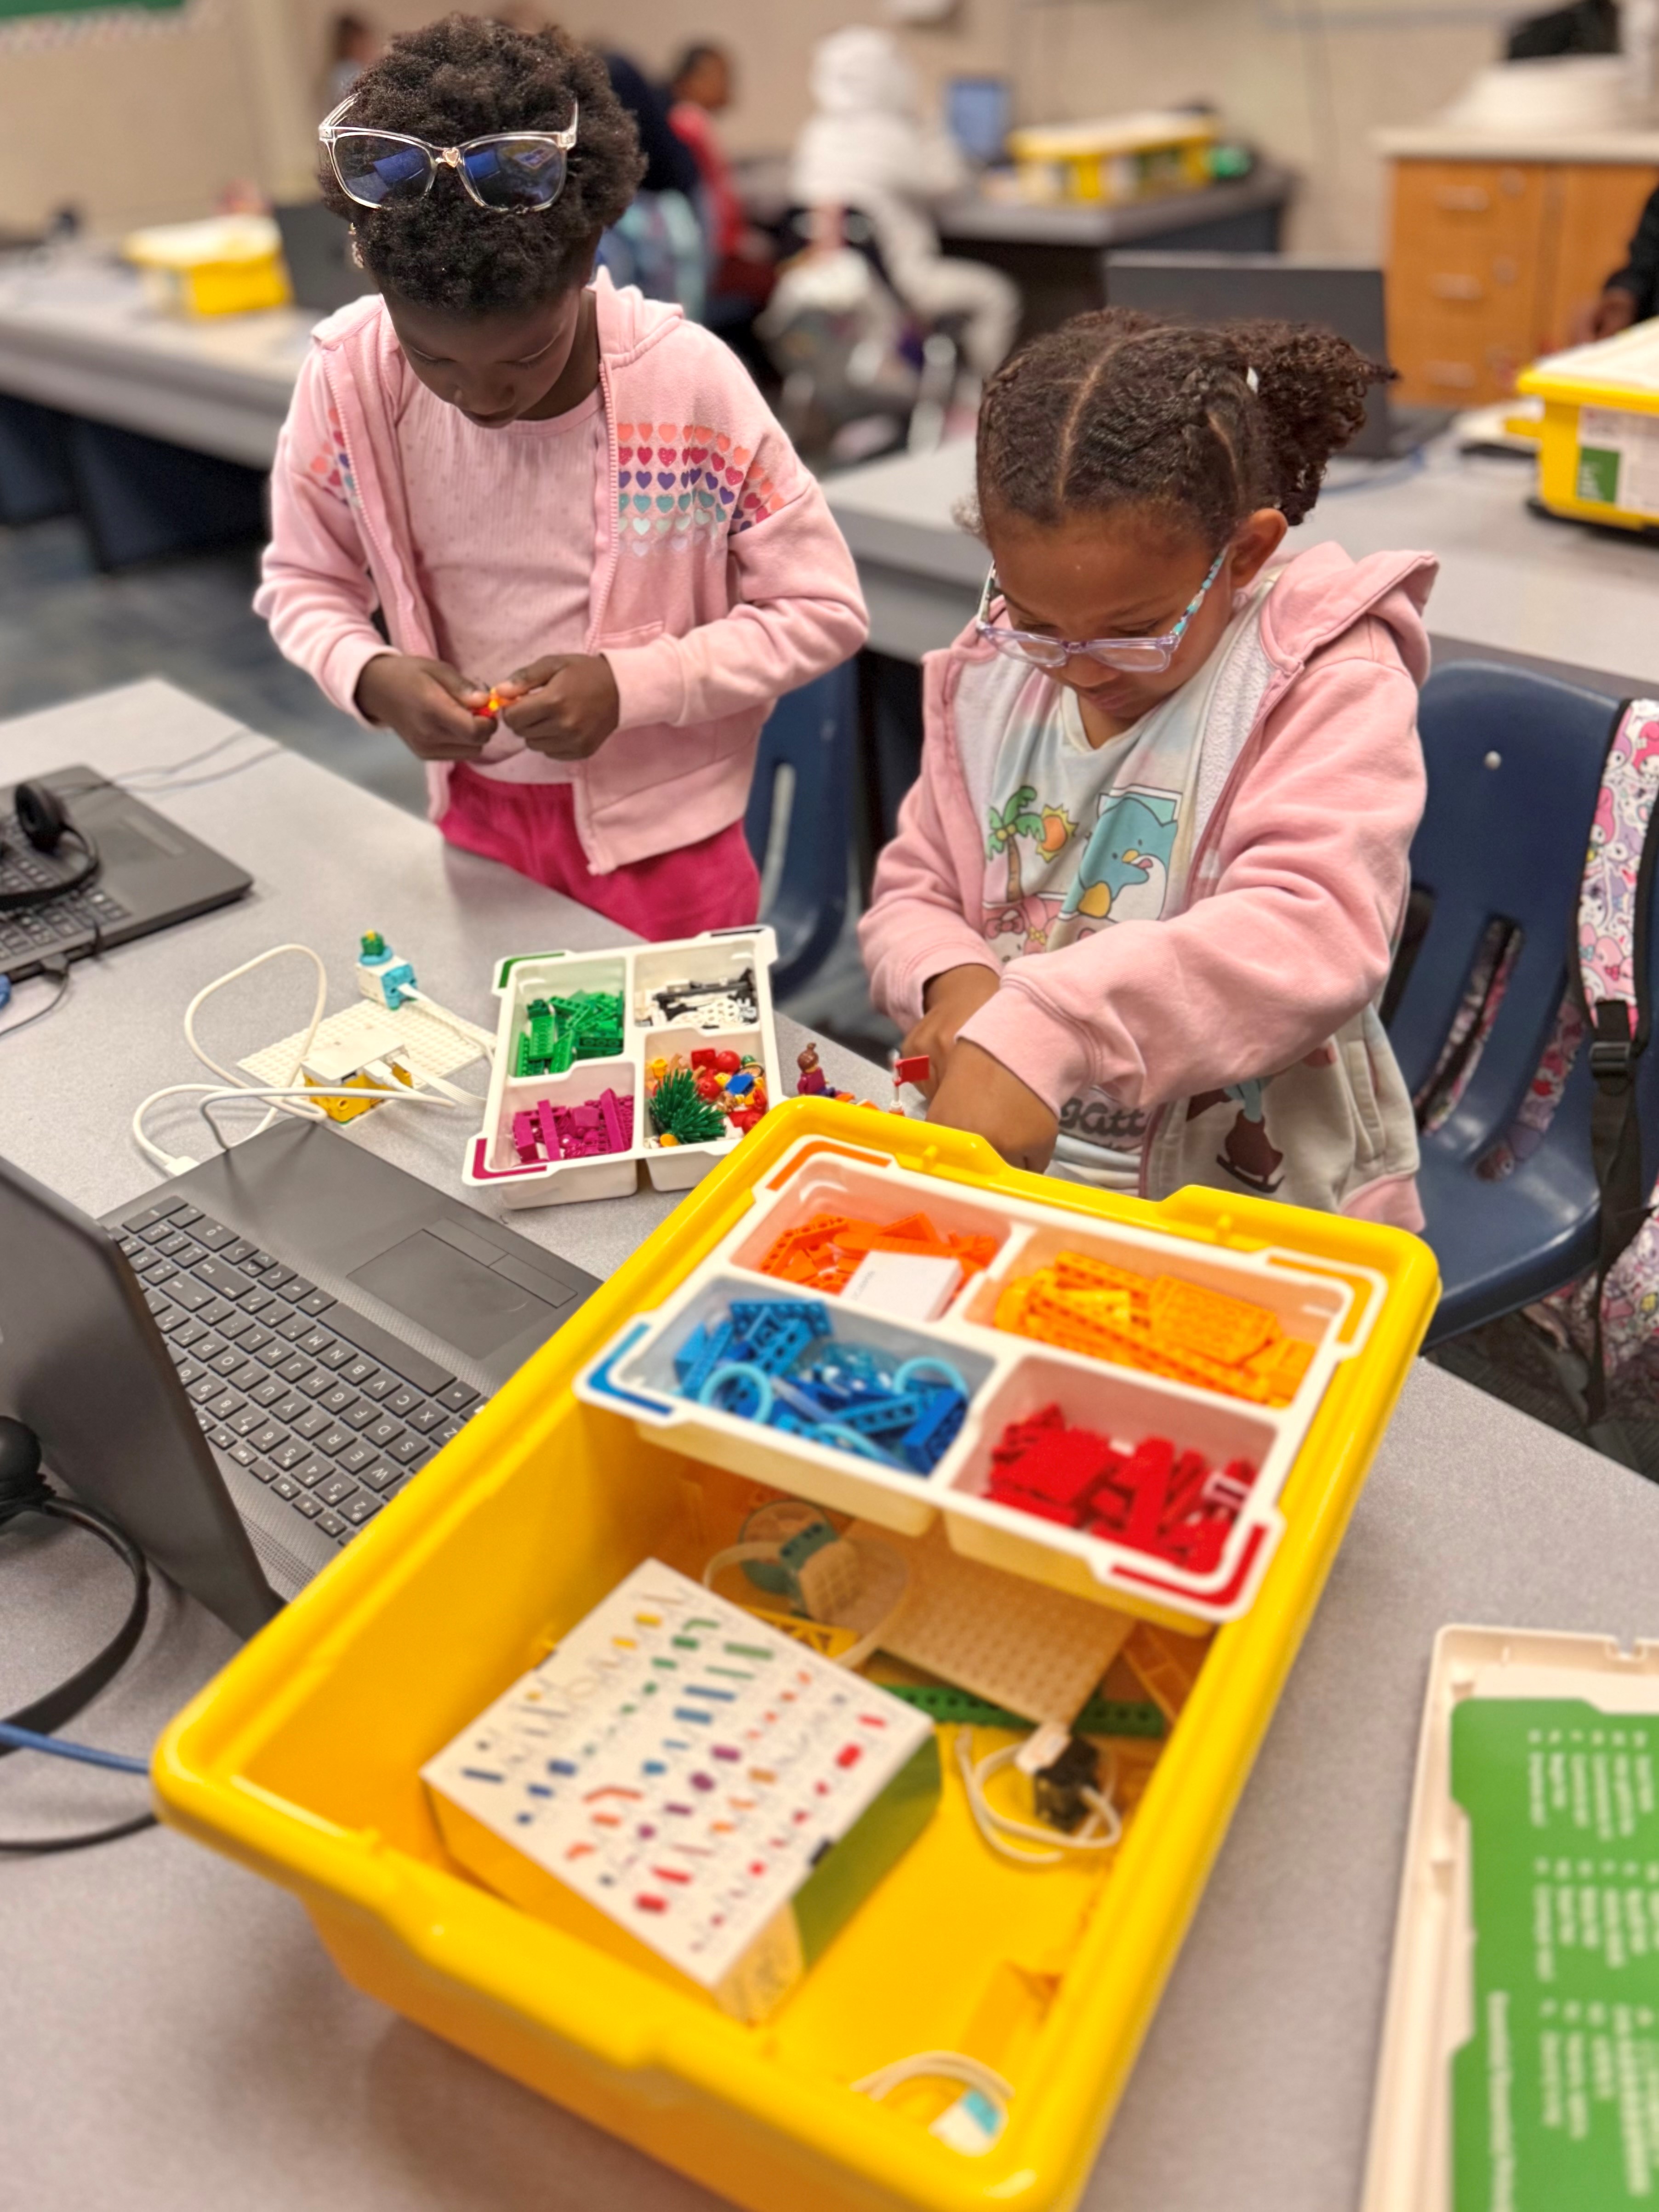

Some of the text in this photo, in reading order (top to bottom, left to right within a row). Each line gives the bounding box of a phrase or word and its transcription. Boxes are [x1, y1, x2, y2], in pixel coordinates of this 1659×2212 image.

[308, 1335, 323, 1345] M
[268, 1349, 282, 1357] K
[331, 1350, 344, 1359] N
[353, 1365, 366, 1374] B
[309, 1377, 324, 1387] H
[373, 1381, 386, 1390] V
[262, 1387, 275, 1396] U
[332, 1392, 344, 1402] G
[397, 1395, 409, 1405] C
[283, 1403, 295, 1412] Y
[354, 1411, 368, 1420] F
[420, 1411, 434, 1422] X
[305, 1419, 317, 1427] T
[378, 1425, 391, 1435] D
[443, 1427, 458, 1438] Z
[328, 1434, 342, 1444] R
[401, 1442, 413, 1451] S
[350, 1451, 365, 1461] E
[371, 1467, 388, 1481] W
[331, 1483, 342, 1492] 3
[354, 1501, 366, 1510] 2
